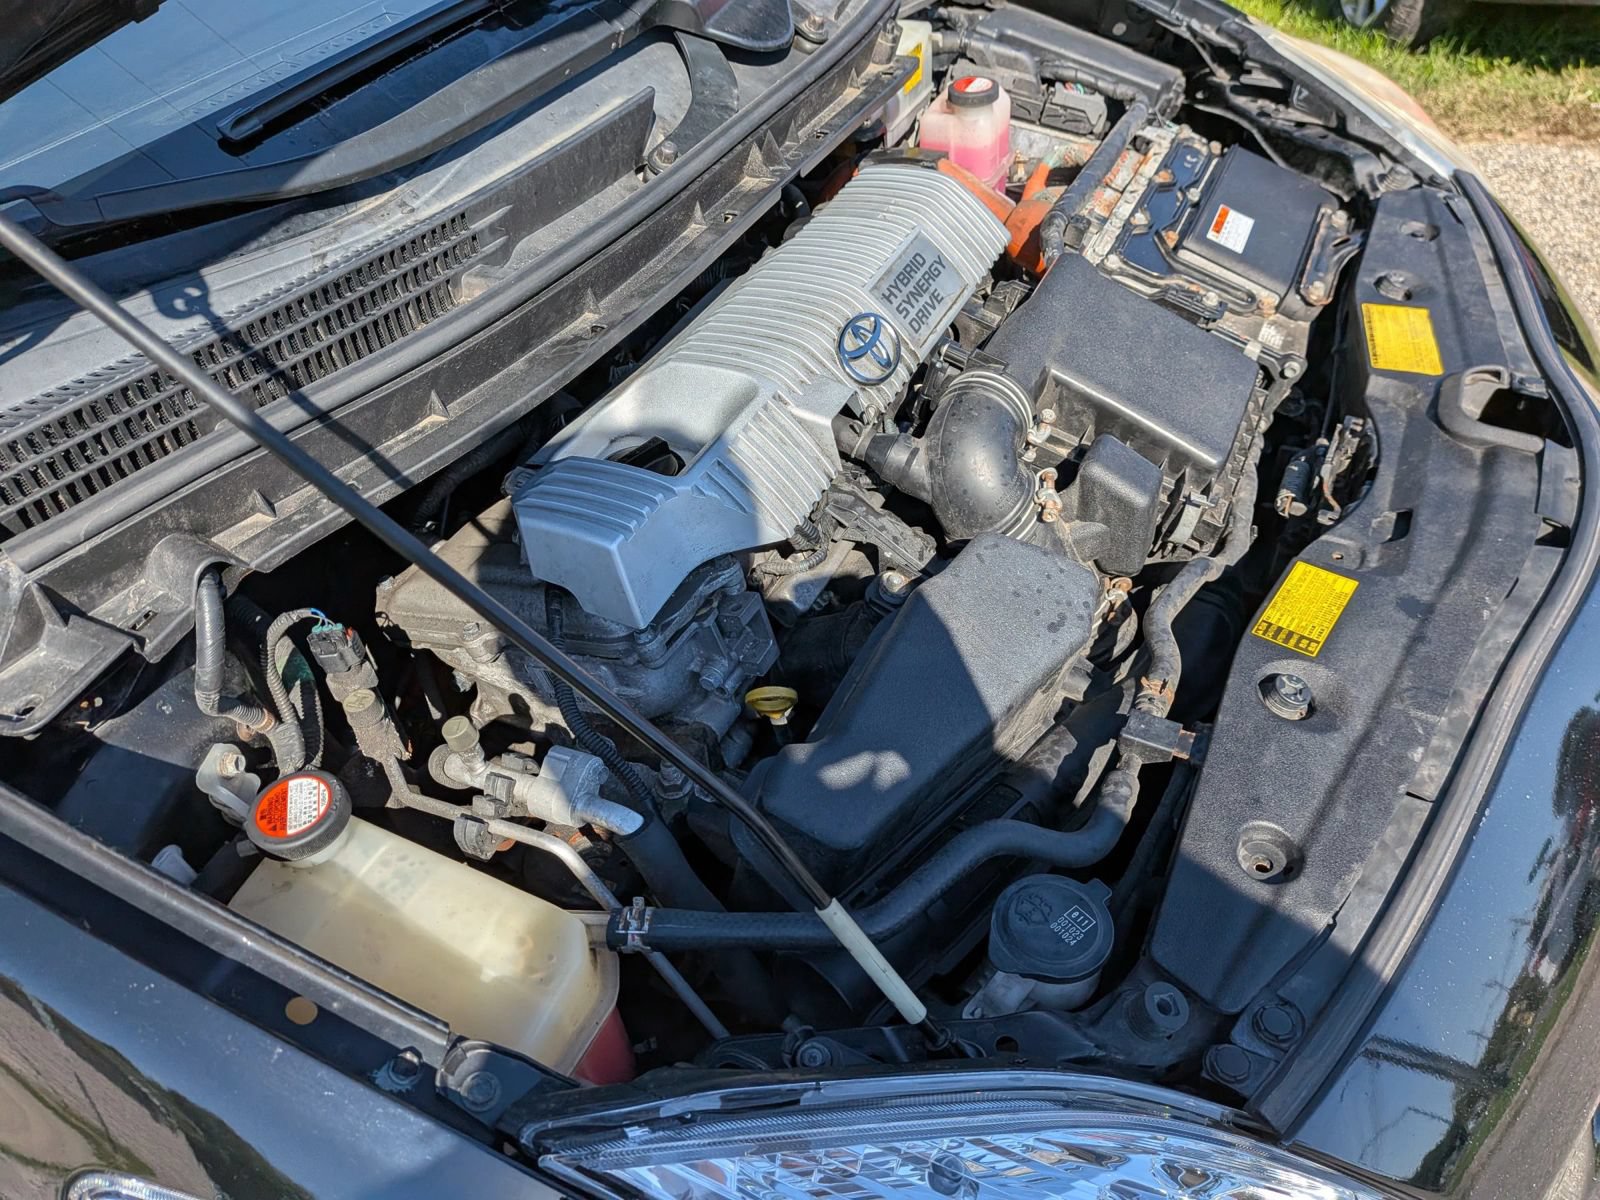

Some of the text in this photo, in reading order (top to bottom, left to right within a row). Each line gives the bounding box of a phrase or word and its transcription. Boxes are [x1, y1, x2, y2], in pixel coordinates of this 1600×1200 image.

[881, 252, 927, 305] HYBRID
[895, 254, 946, 320] SYNERGY
[908, 288, 944, 334] DRIVE
[1050, 922, 1078, 946] 001024
[1057, 916, 1084, 941] 001023
